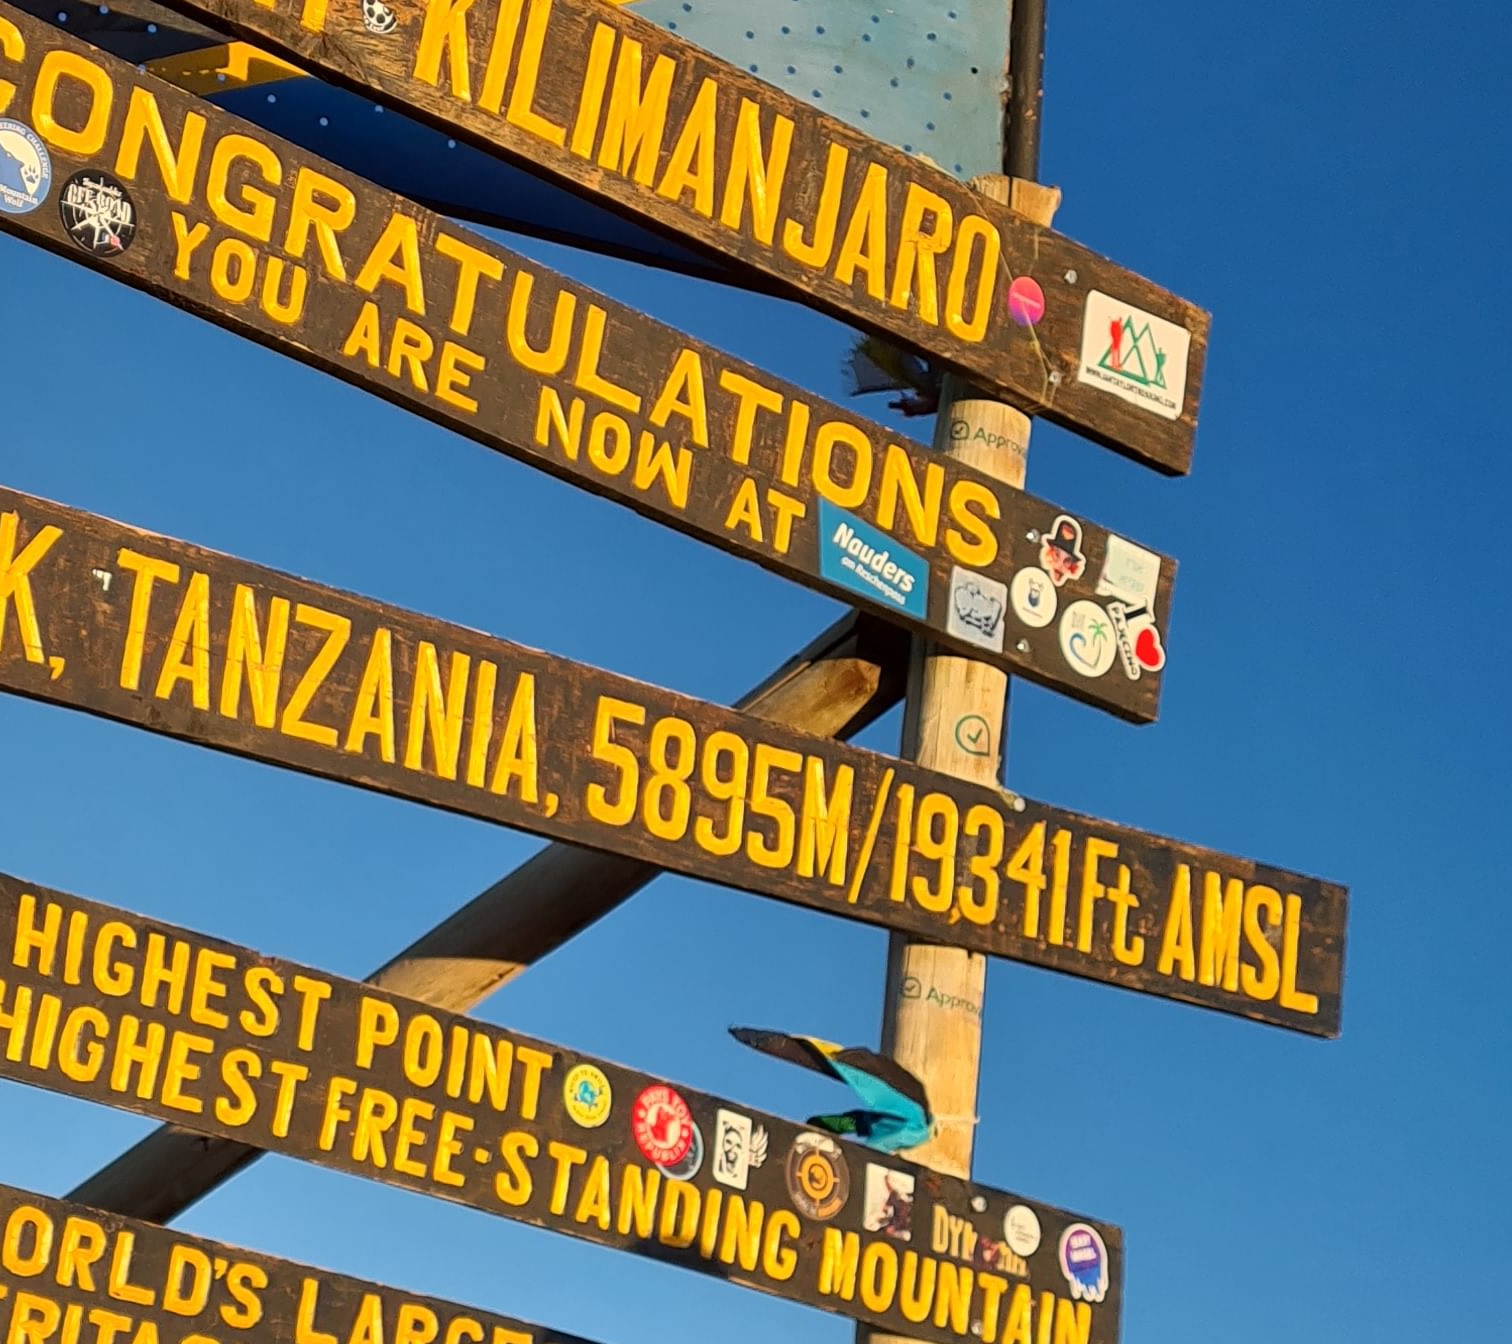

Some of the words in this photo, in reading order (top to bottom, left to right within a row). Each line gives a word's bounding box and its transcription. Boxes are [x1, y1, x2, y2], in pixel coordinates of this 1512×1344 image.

[4, 195, 24, 208] Wolf
[169, 210, 309, 331] YOU
[338, 300, 486, 417] ARE
[531, 387, 695, 513] NOW
[721, 474, 807, 557] AT
[832, 522, 916, 593] Nauders
[114, 547, 561, 820] TANZANIA,
[1155, 866, 1318, 1015] AMSL
[9, 893, 331, 1055] HIGHEST
[354, 993, 553, 1124] POINT
[316, 1074, 800, 1283] FREE-STANDING
